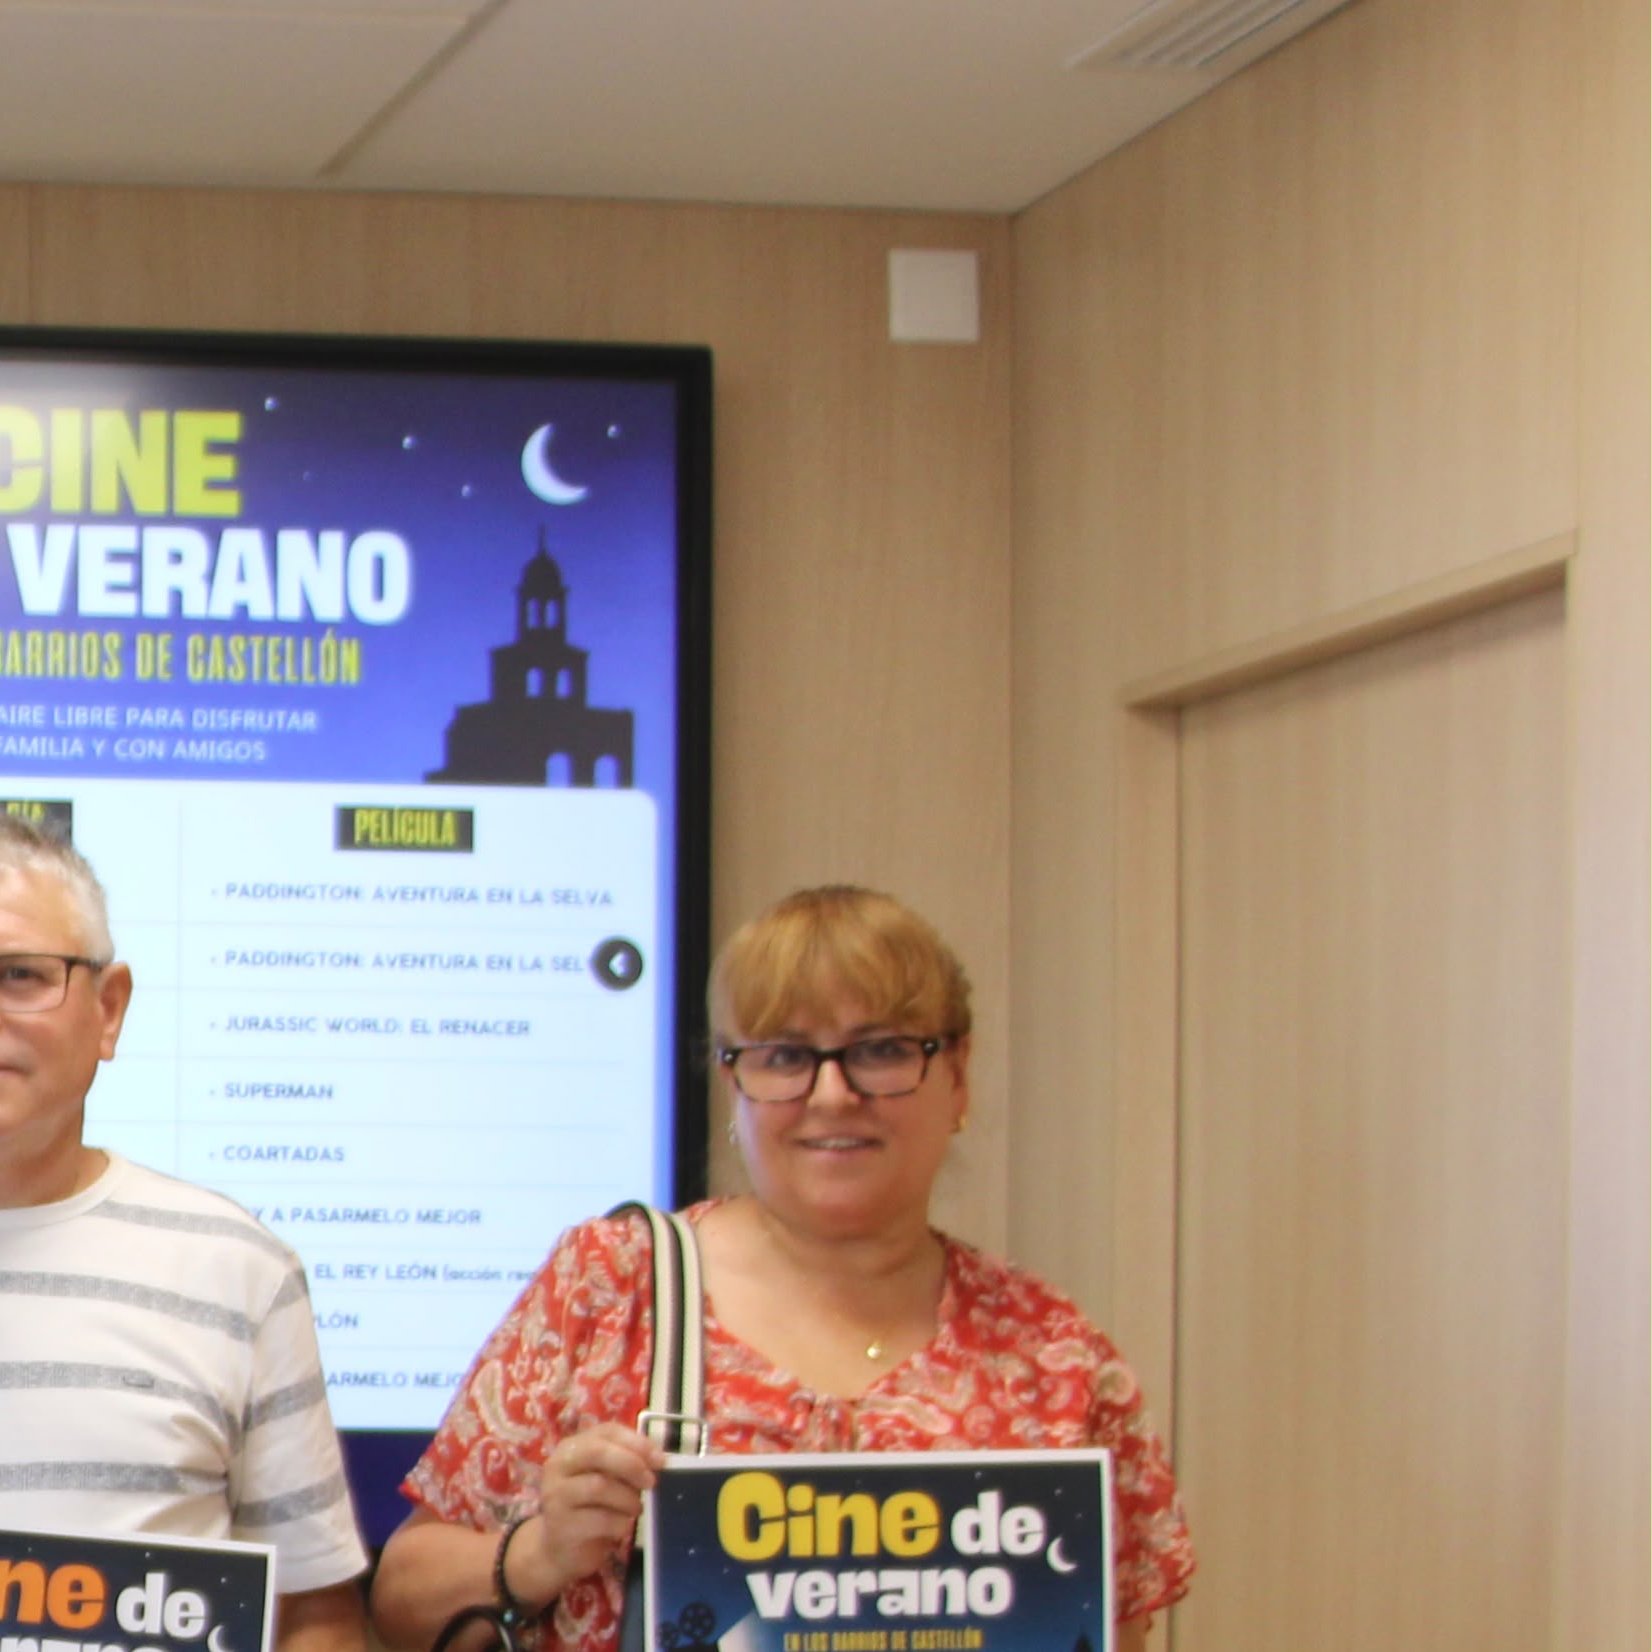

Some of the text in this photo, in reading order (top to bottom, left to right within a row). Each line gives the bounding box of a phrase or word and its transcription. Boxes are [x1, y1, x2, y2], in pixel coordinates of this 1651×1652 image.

[6, 523, 411, 624] VERANO
[136, 634, 173, 683] DE
[187, 626, 358, 685] CASTELLÓN
[54, 704, 116, 729] LIBRE
[125, 706, 183, 729] PARA
[191, 709, 316, 731] DISFRUTAR
[92, 738, 105, 759] Y
[114, 739, 165, 760] CON
[173, 740, 266, 761] AMIGOS
[354, 808, 457, 846] PELÍCULA
[374, 886, 479, 904] AVENTURA
[487, 888, 513, 904] EN
[520, 889, 543, 905] LA
[552, 889, 613, 906] SELVA
[225, 1017, 317, 1033] JURASSIC
[411, 1019, 432, 1035] EL
[440, 1020, 529, 1035] RENACER
[225, 1083, 333, 1099] SUPERMAN
[224, 1146, 344, 1162] COARTADAS
[272, 1208, 481, 1225] A PASARMELO MEJOR
[315, 1265, 335, 1279] EL
[343, 1265, 379, 1280] REY
[386, 1262, 436, 1280] LEÓN
[717, 1471, 1045, 1561] Cine de
[116, 1572, 205, 1638] de
[745, 1567, 1012, 1619] verano
